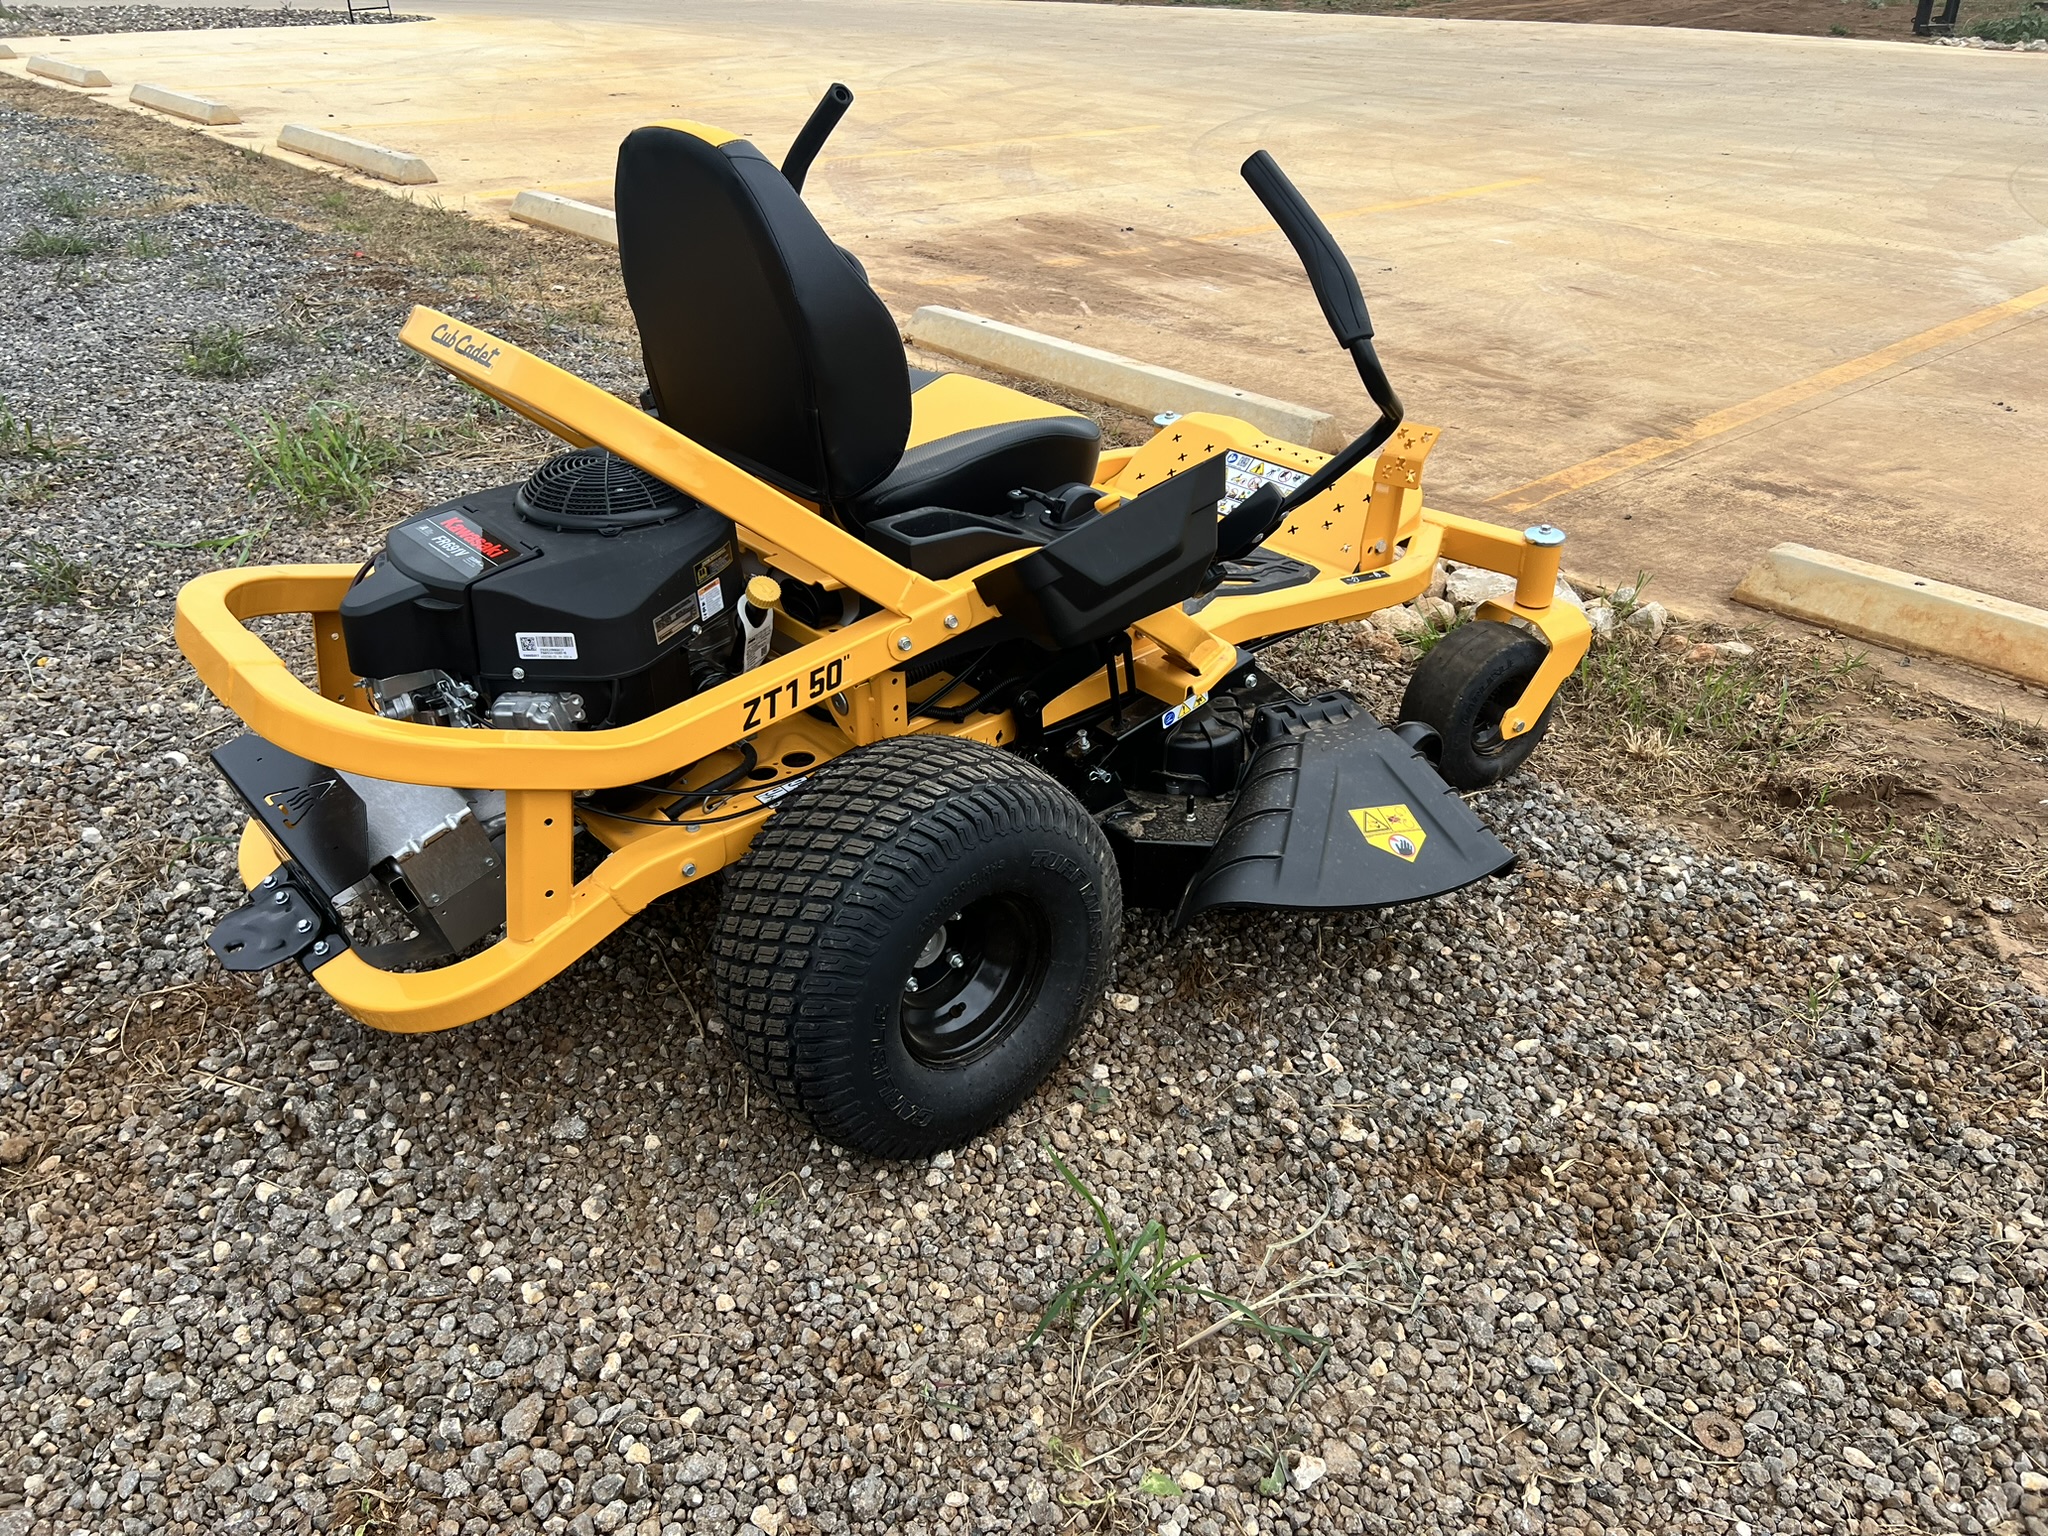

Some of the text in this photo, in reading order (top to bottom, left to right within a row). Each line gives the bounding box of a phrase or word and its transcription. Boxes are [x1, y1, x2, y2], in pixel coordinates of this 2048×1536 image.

[431, 323, 500, 368] Cub Cadet
[440, 517, 509, 558] Kawasaki
[743, 678, 798, 732] ZT1
[1030, 850, 1087, 883] TURF
